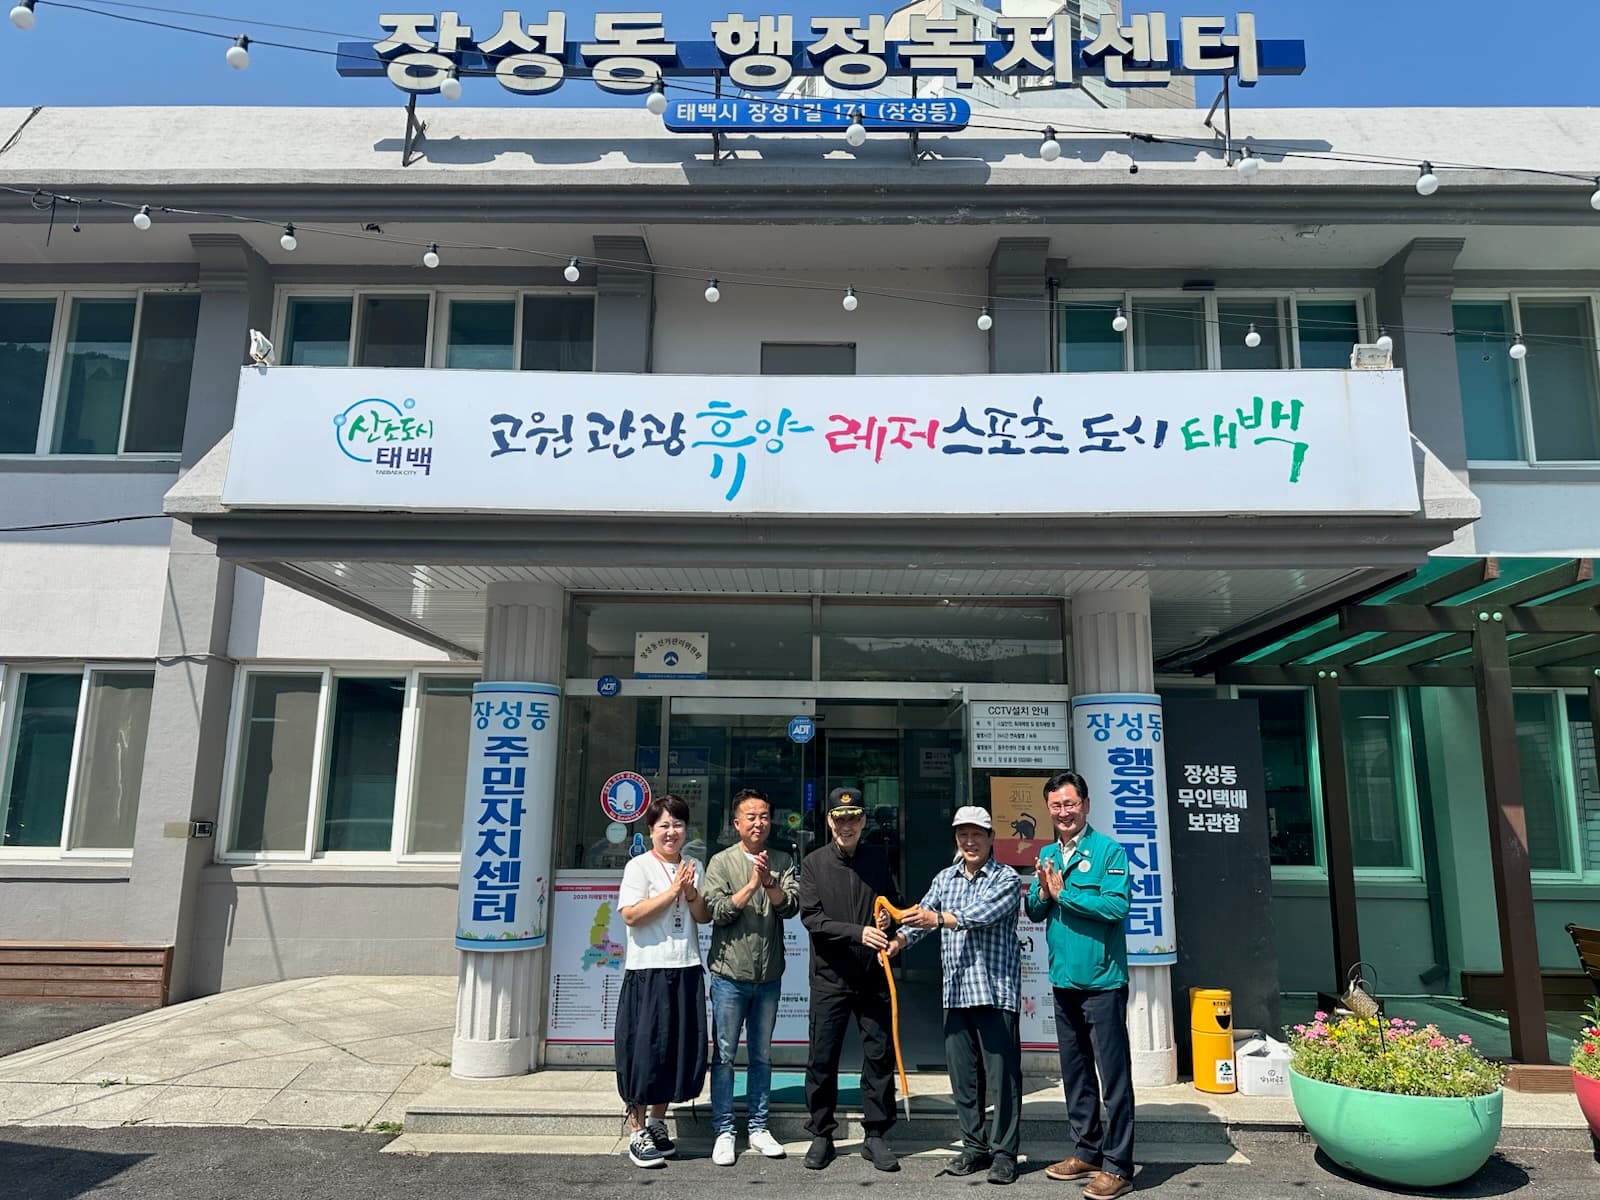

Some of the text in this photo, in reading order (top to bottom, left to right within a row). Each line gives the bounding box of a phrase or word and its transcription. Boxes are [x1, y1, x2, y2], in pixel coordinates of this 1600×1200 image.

[372, 11, 1258, 94] 장성동 행정복지센터
[677, 103, 737, 122] 태백시
[878, 102, 958, 122] (장성동)
[348, 409, 433, 443] 산소도시
[376, 446, 432, 476] 태백
[692, 400, 815, 500] 휴양
[1078, 413, 1169, 453] 도시
[1180, 396, 1310, 484] 태백
[473, 701, 551, 731] 장성동
[988, 706, 1049, 716] CCTV설치 안내
[792, 724, 811, 735] ADT
[1086, 713, 1162, 743] 장성동
[1184, 765, 1237, 785] 장성동
[1178, 789, 1248, 809] 무인택배
[472, 736, 529, 923] 주민자치센터
[1188, 813, 1240, 833] 보관함
[1107, 747, 1163, 937] 행정복지센터
